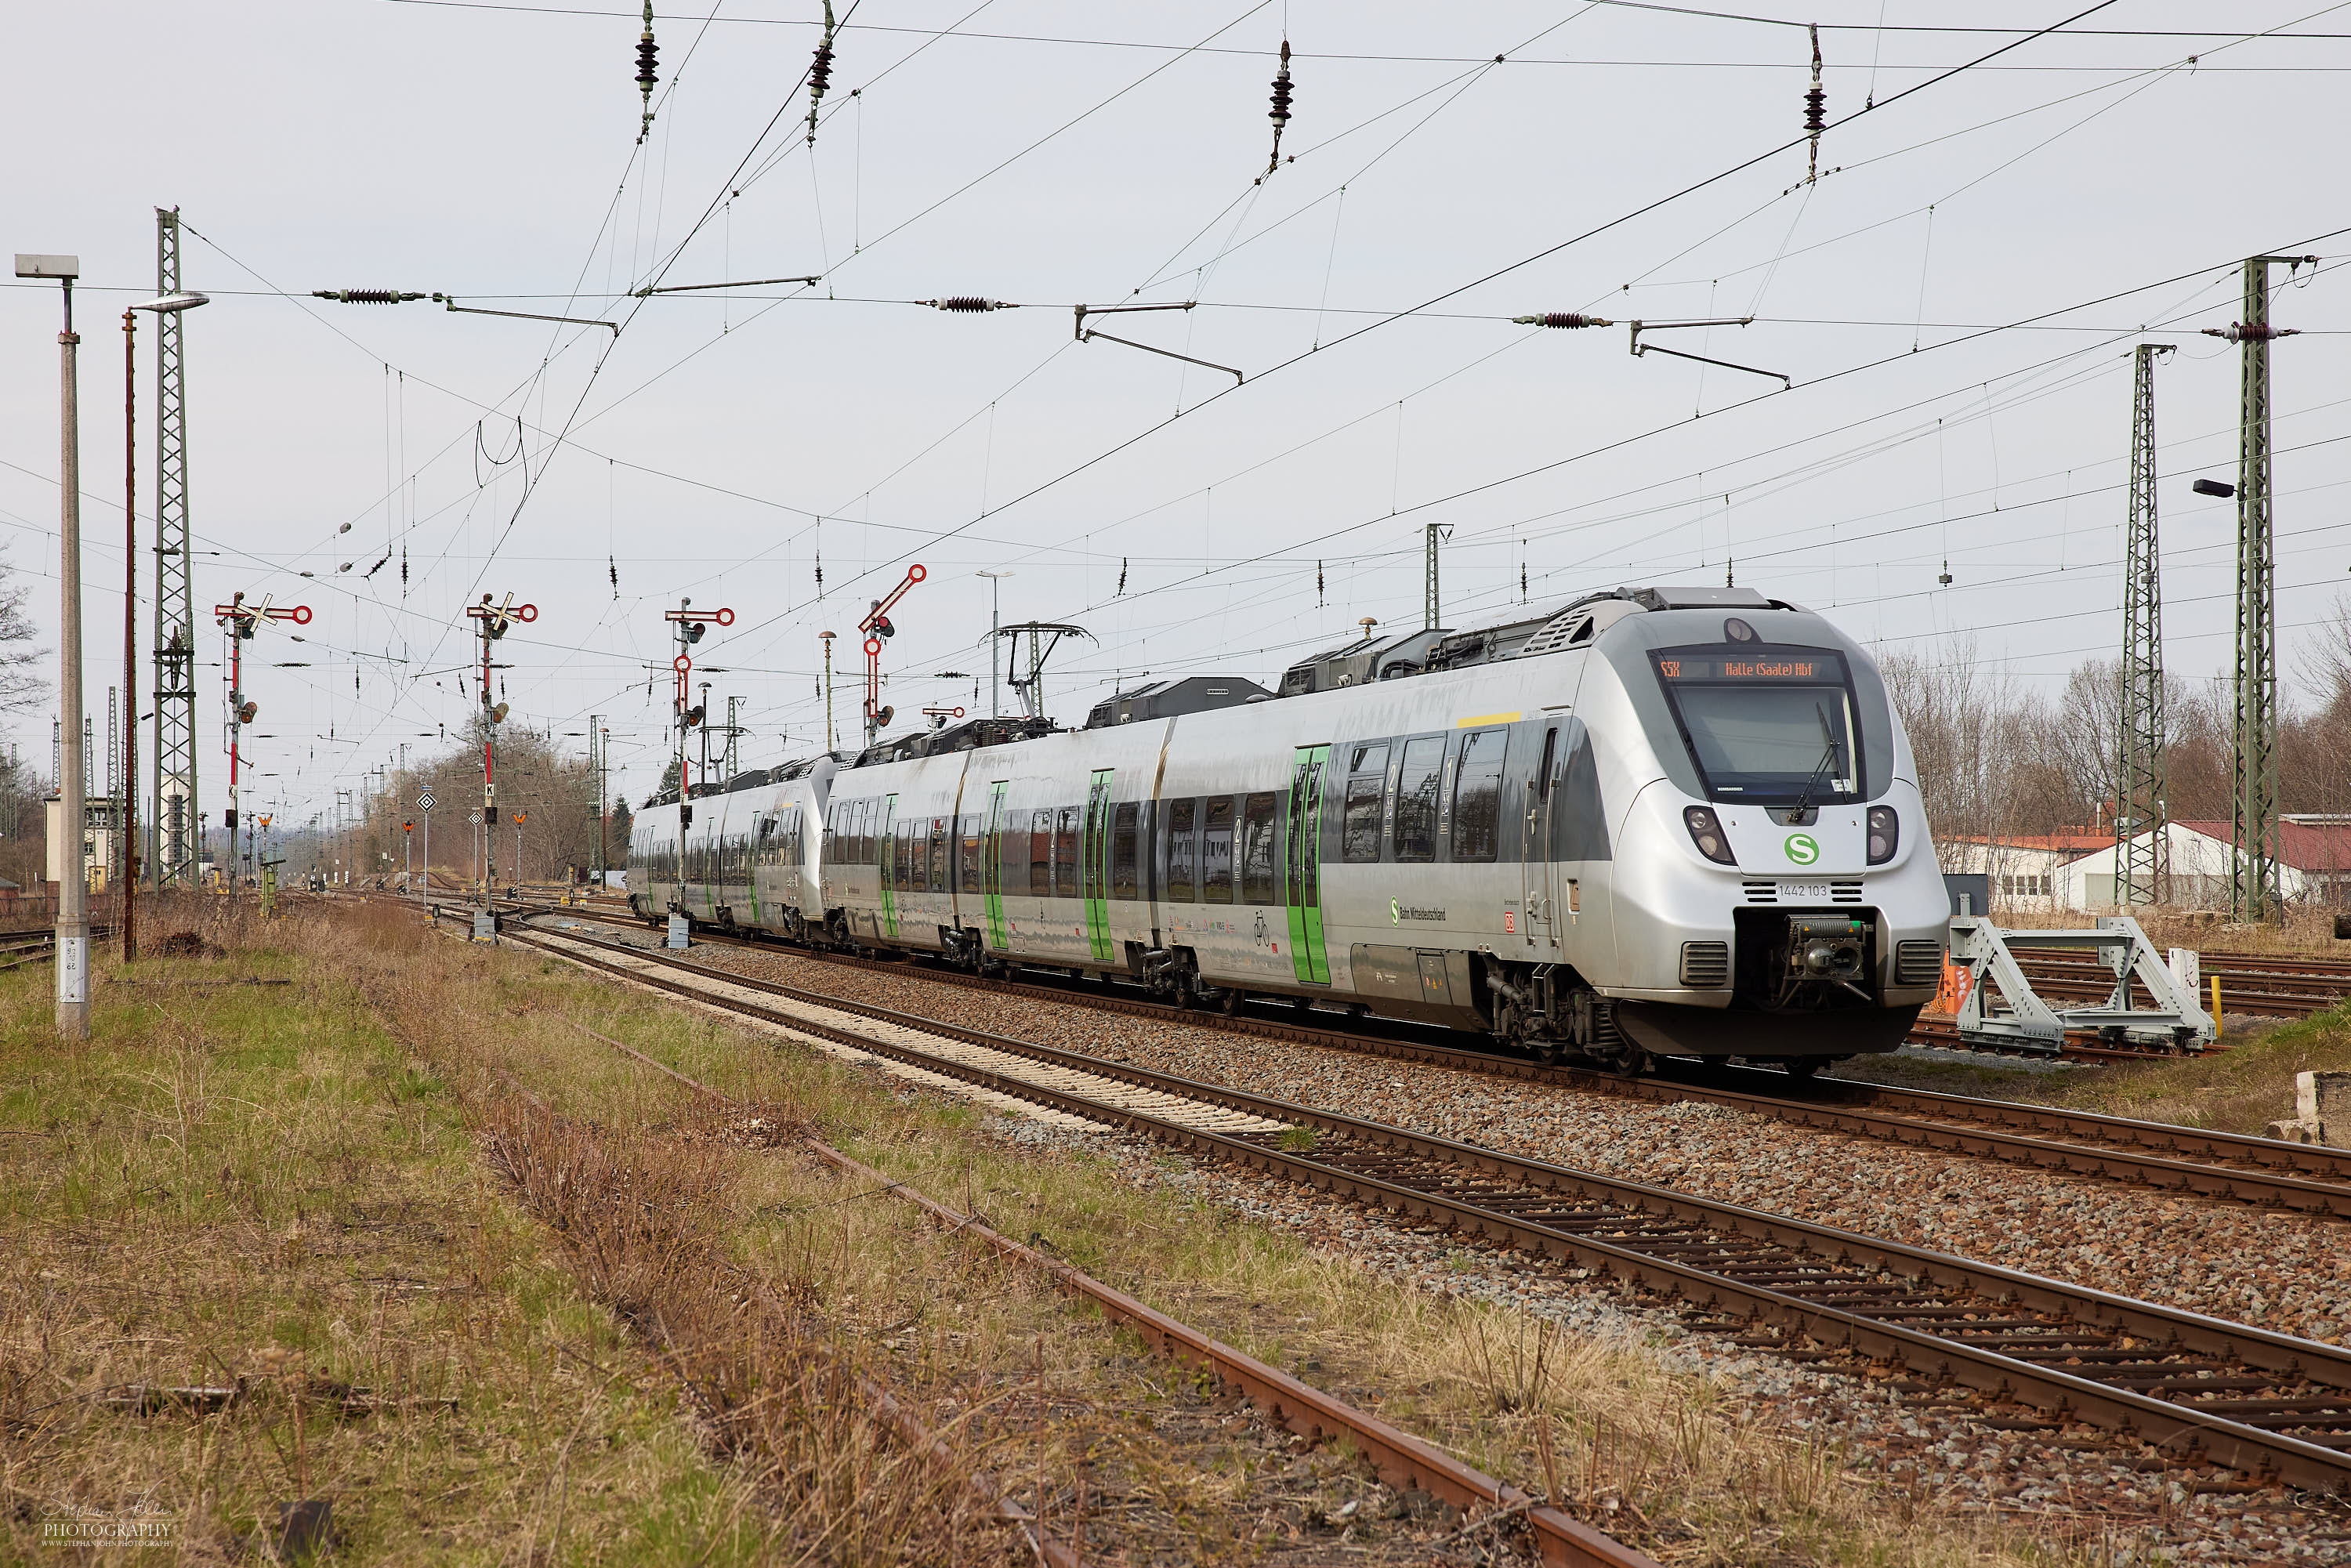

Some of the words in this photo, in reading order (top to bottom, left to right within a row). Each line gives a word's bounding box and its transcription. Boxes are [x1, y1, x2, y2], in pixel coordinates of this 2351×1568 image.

[1726, 662, 1753, 675] Halle
[1756, 662, 1793, 676] (Saale)
[1795, 662, 1813, 675] Hbf
[1388, 764, 1396, 792] 2
[1446, 758, 1453, 788] 1
[487, 786, 494, 795] K
[1235, 818, 1241, 843] 2
[1788, 835, 1817, 864] S
[1779, 885, 1806, 896] 1442
[1808, 885, 1827, 896] 103
[1400, 907, 1410, 919] Bahn
[1411, 907, 1446, 921] Mitteldeutschland
[1505, 913, 1514, 932] DB
